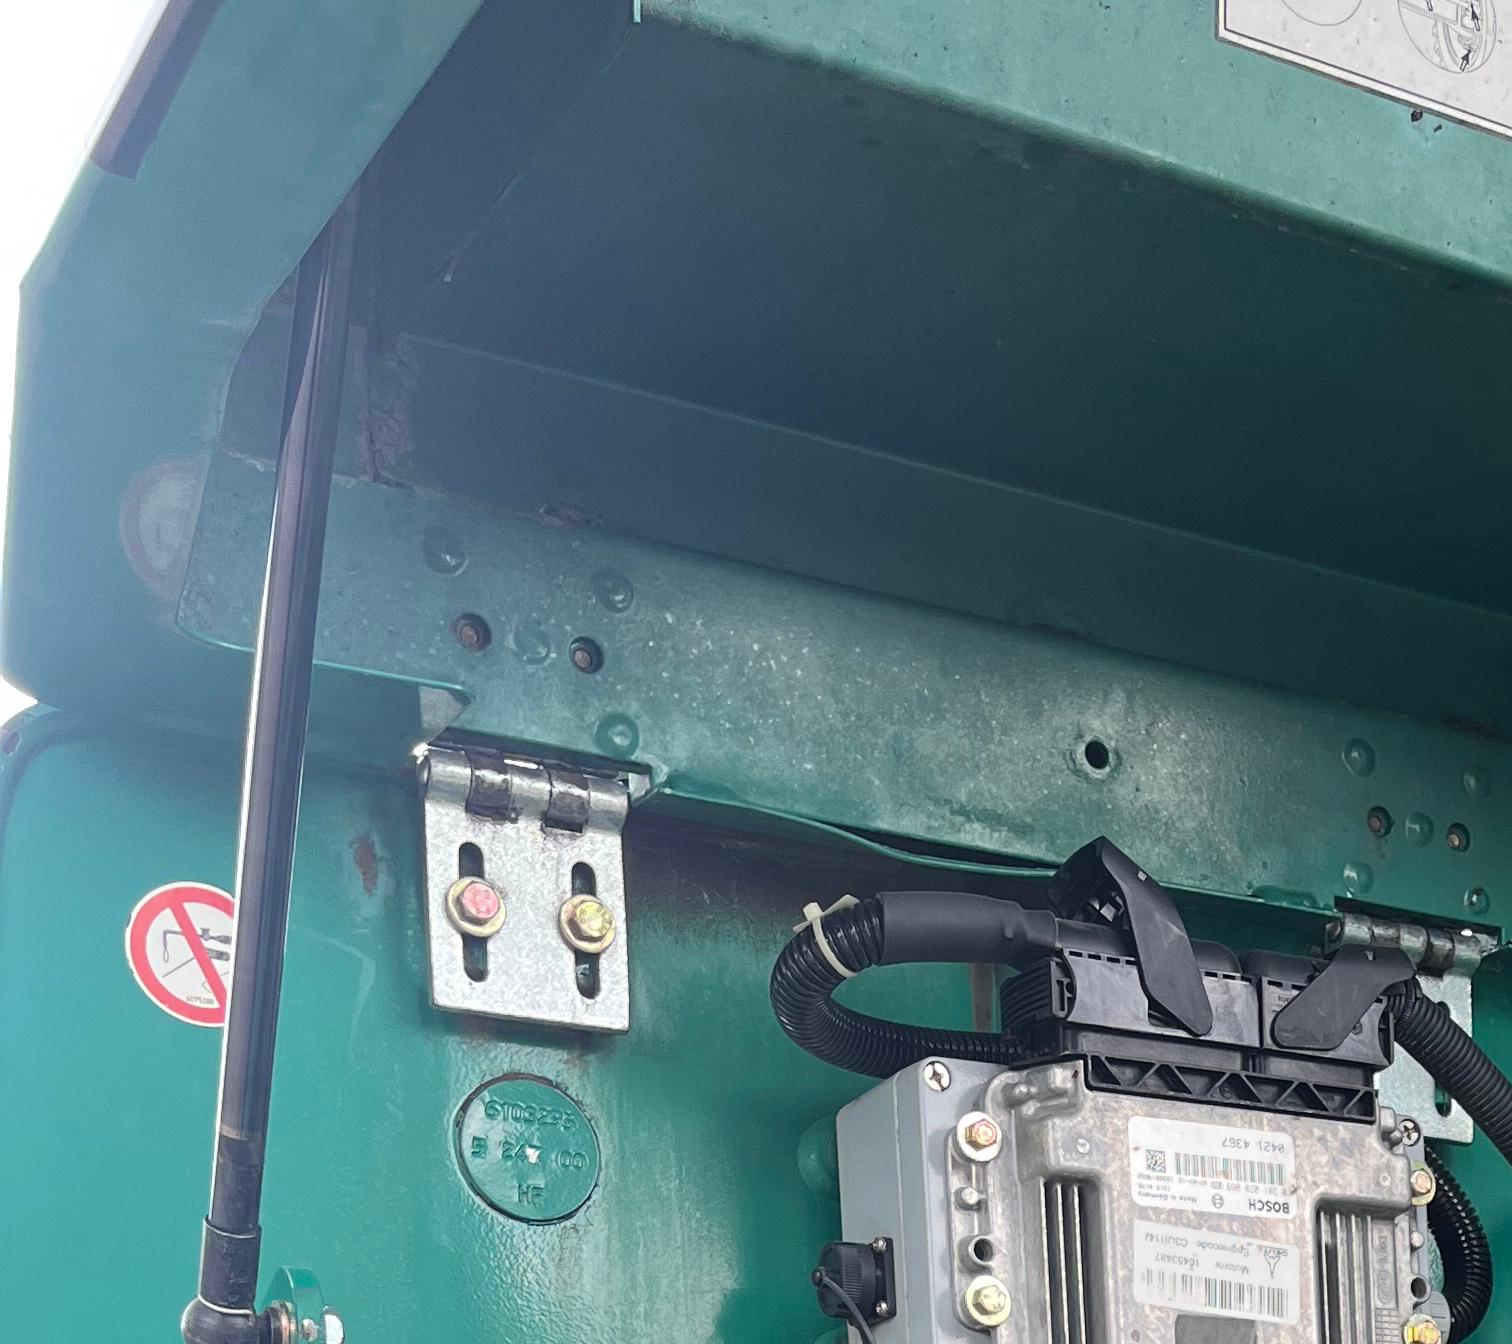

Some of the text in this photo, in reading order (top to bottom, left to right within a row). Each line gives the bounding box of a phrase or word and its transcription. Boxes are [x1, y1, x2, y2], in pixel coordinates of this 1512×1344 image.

[1222, 1136, 1285, 1154] 0421 4367
[1248, 1199, 1290, 1215] BOSCH
